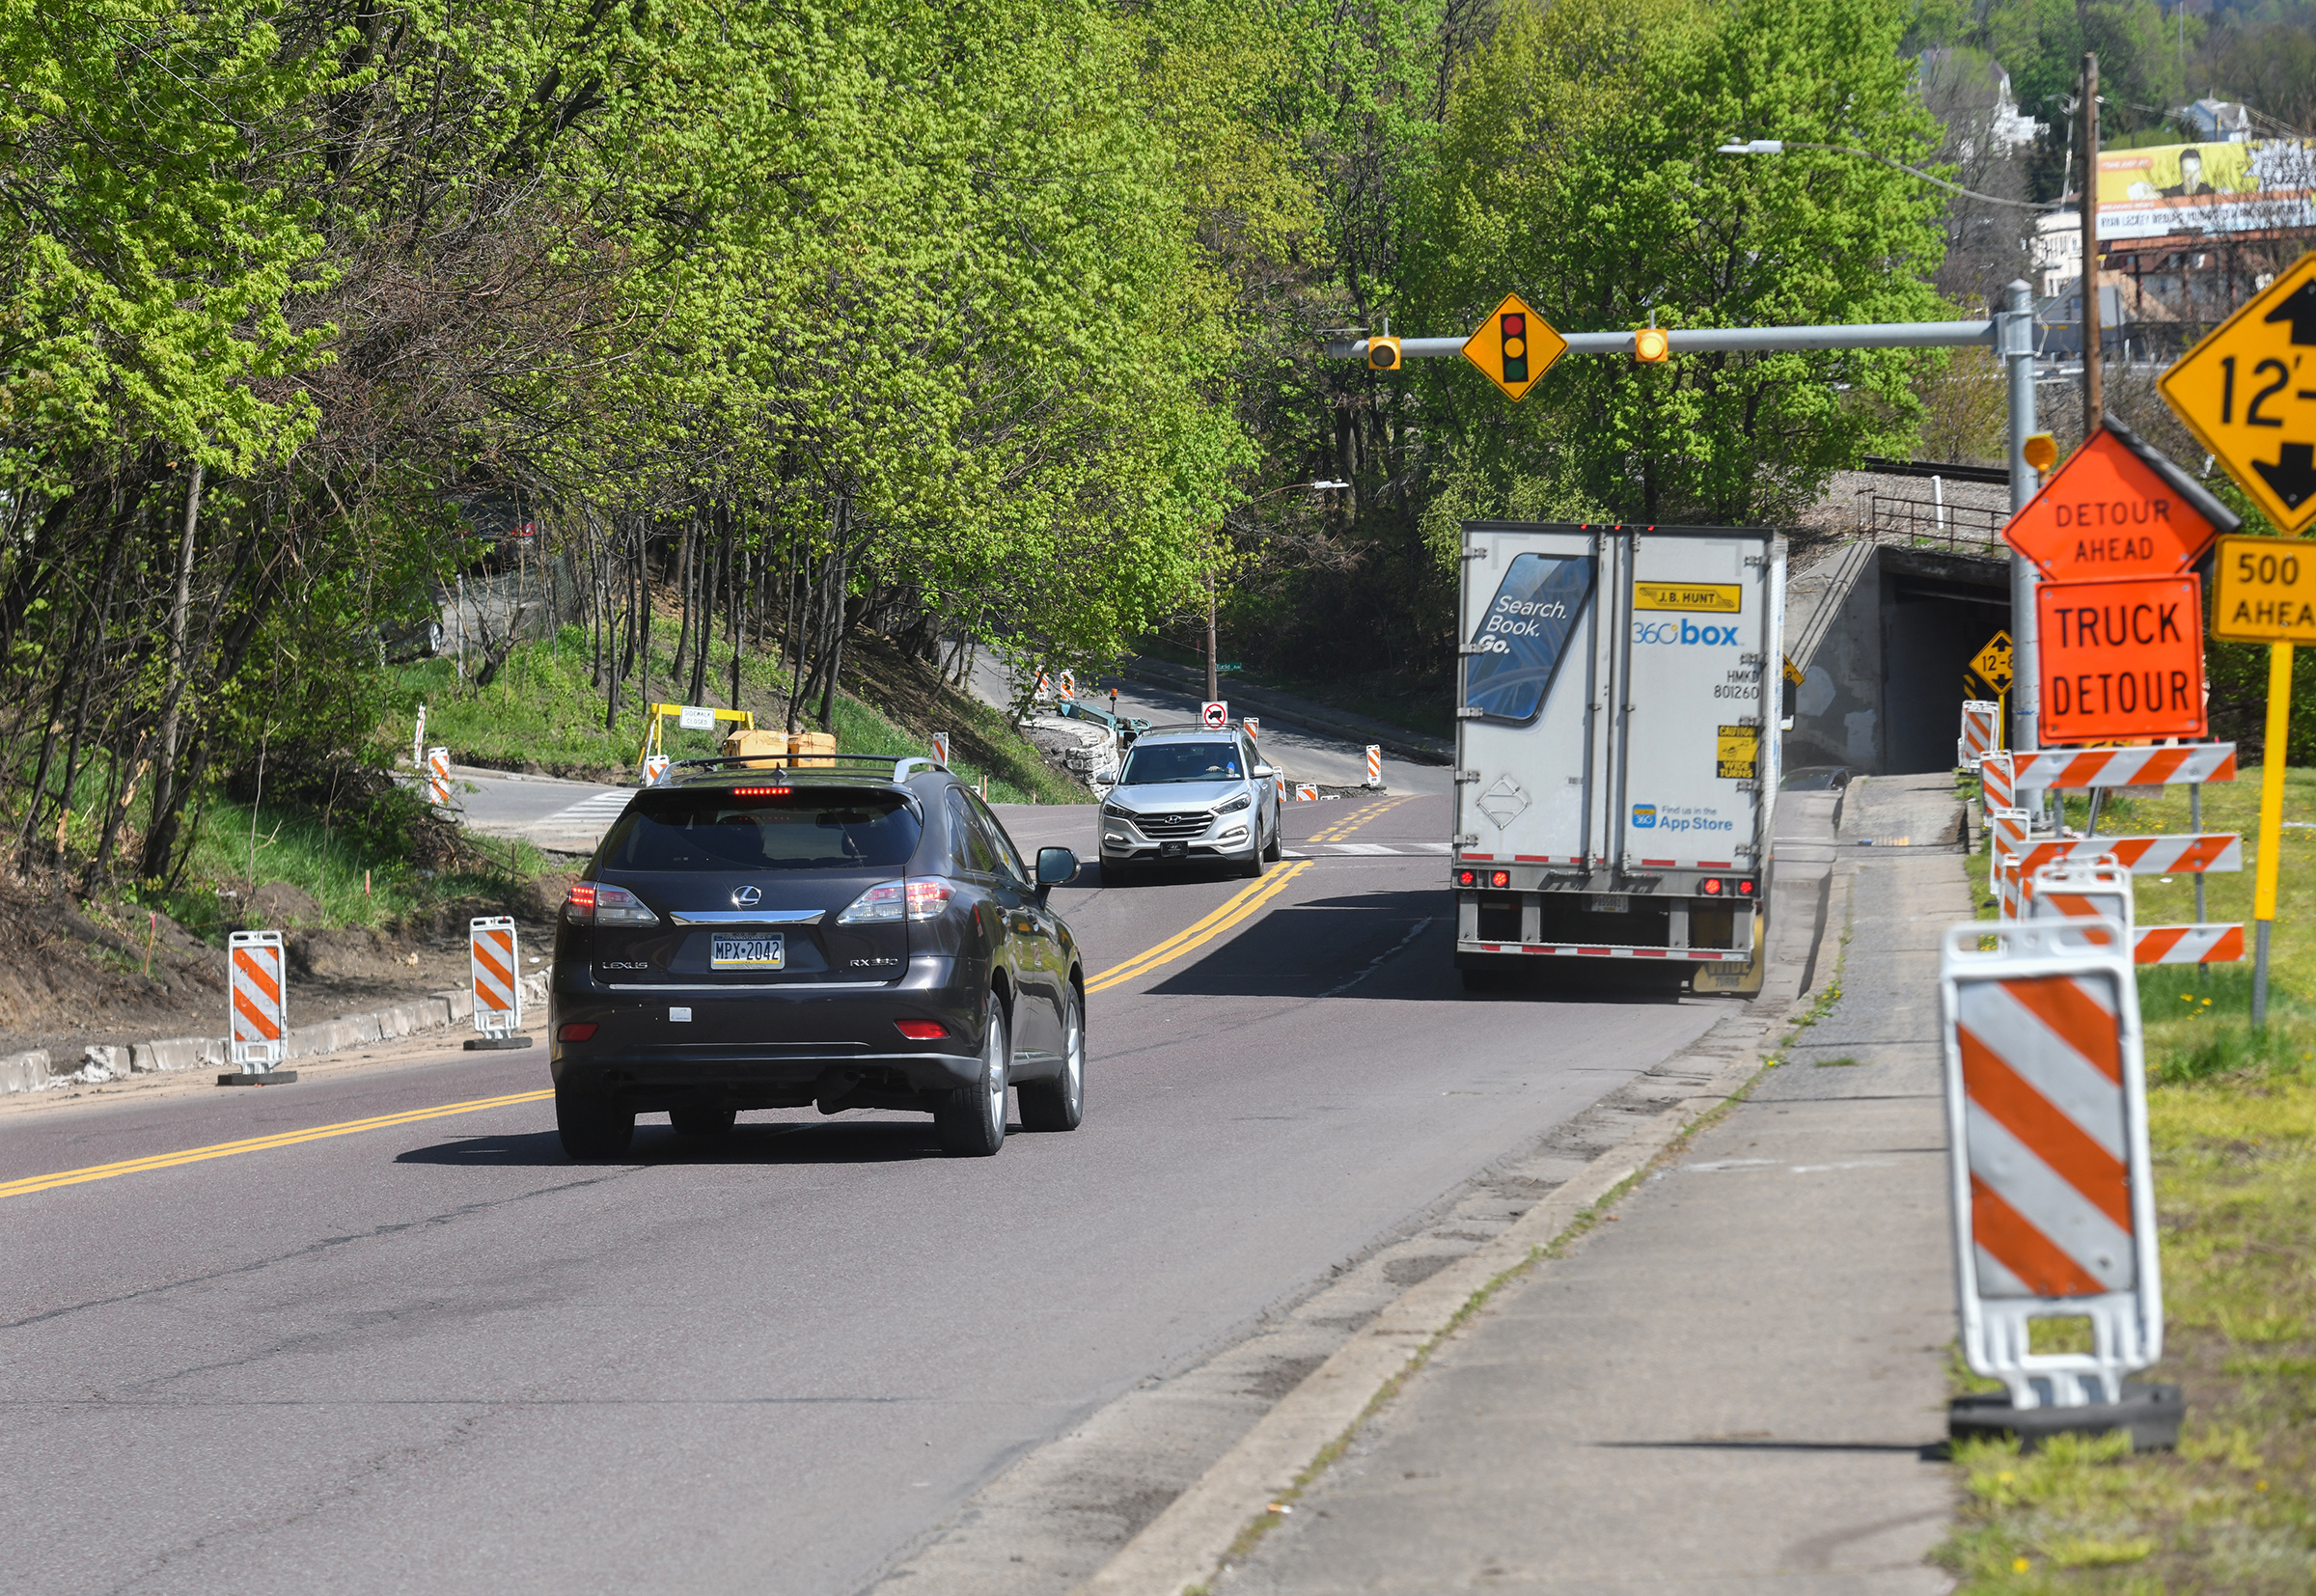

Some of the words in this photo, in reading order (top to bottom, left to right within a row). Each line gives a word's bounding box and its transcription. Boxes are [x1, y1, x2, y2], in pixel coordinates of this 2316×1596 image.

[2055, 499, 2169, 528] DETOUR
[2075, 537, 2154, 563] AHEAD
[2238, 553, 2299, 586] 500
[1682, 592, 1716, 604] HUNT
[1495, 594, 1567, 619] Search.
[1486, 615, 1540, 637] Book.
[2054, 602, 2182, 648] TRUCK
[1478, 634, 1511, 654] Go.
[1726, 670, 1759, 684] HMKD
[1714, 684, 1759, 700] 801260
[2054, 671, 2189, 716] DETOUR
[684, 709, 711, 718] SIDEWALK
[1719, 726, 1756, 737] CAUTION
[1719, 768, 1753, 779] TURNS
[1723, 760, 1751, 771] WIDE
[1662, 805, 1680, 814] Find
[1694, 807, 1702, 815] in
[1704, 807, 1718, 815] the
[1660, 815, 1690, 832] App
[1693, 816, 1733, 831] Store
[602, 961, 648, 970] LEXUS
